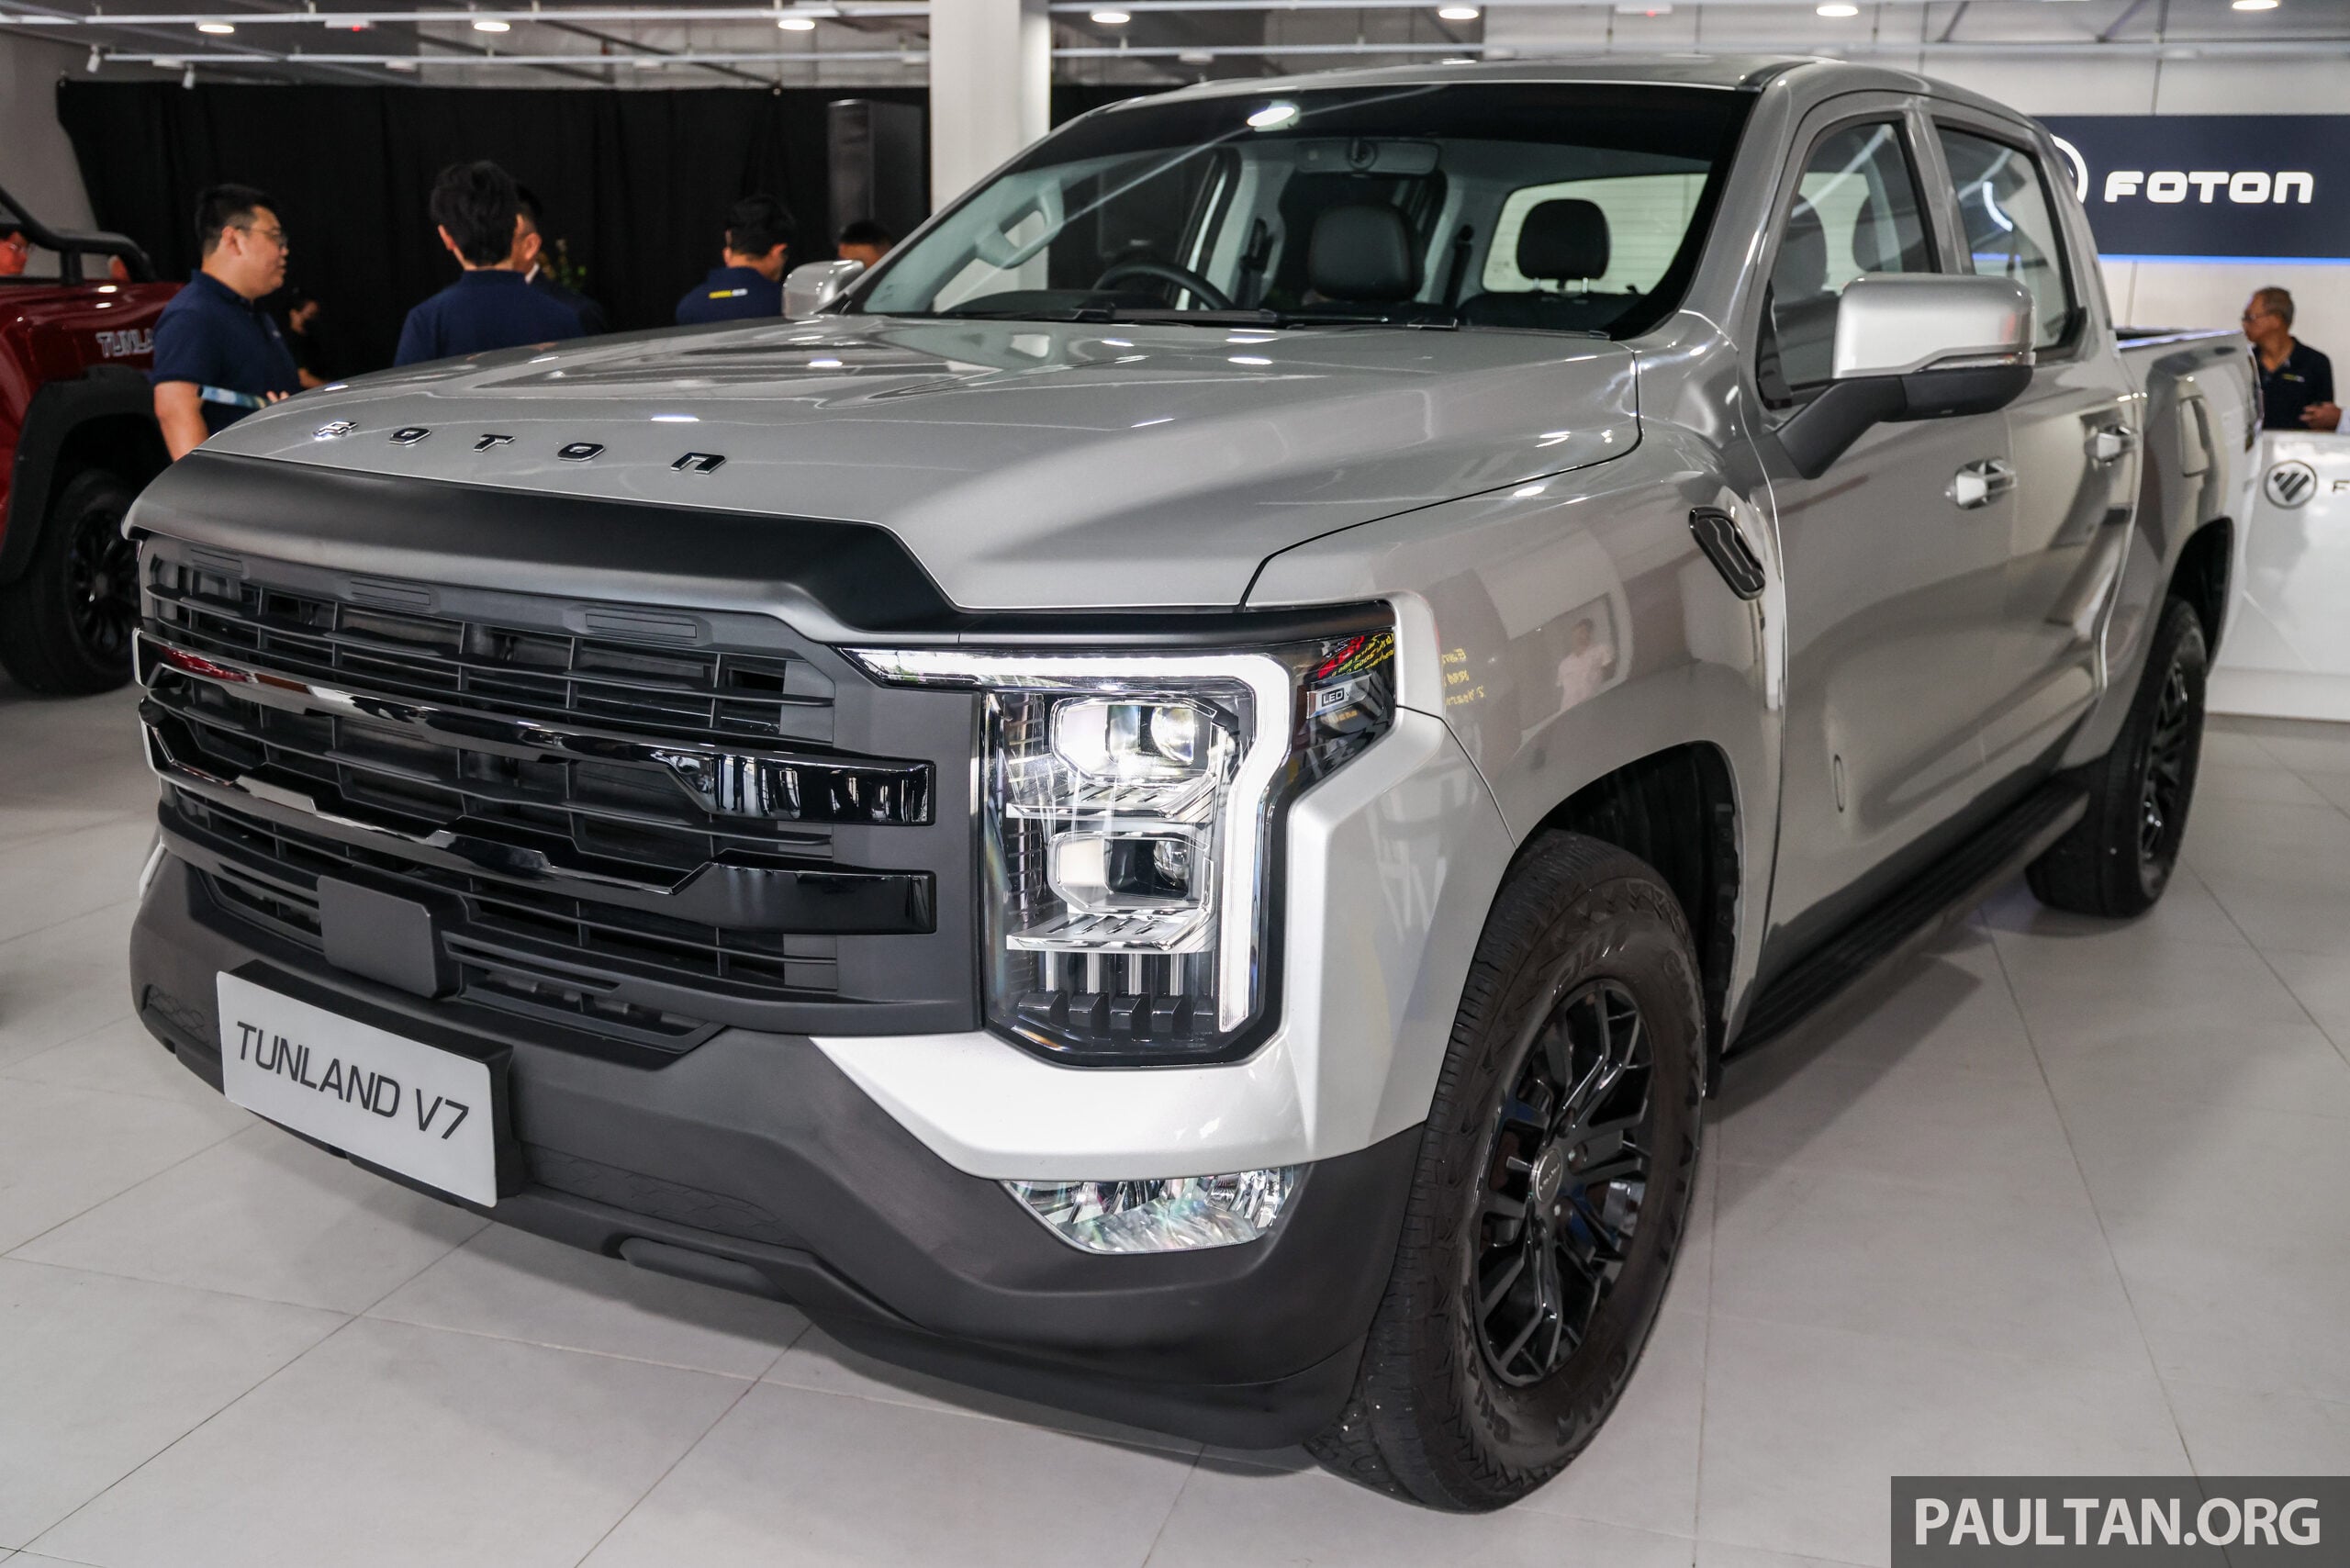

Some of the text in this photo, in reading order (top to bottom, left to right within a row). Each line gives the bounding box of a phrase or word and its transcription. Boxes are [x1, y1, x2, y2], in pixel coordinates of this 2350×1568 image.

[2104, 171, 2314, 204] FOTON
[313, 420, 727, 475] FOTON
[1322, 689, 1344, 705] LED
[237, 1021, 469, 1140] TUNLAND V7
